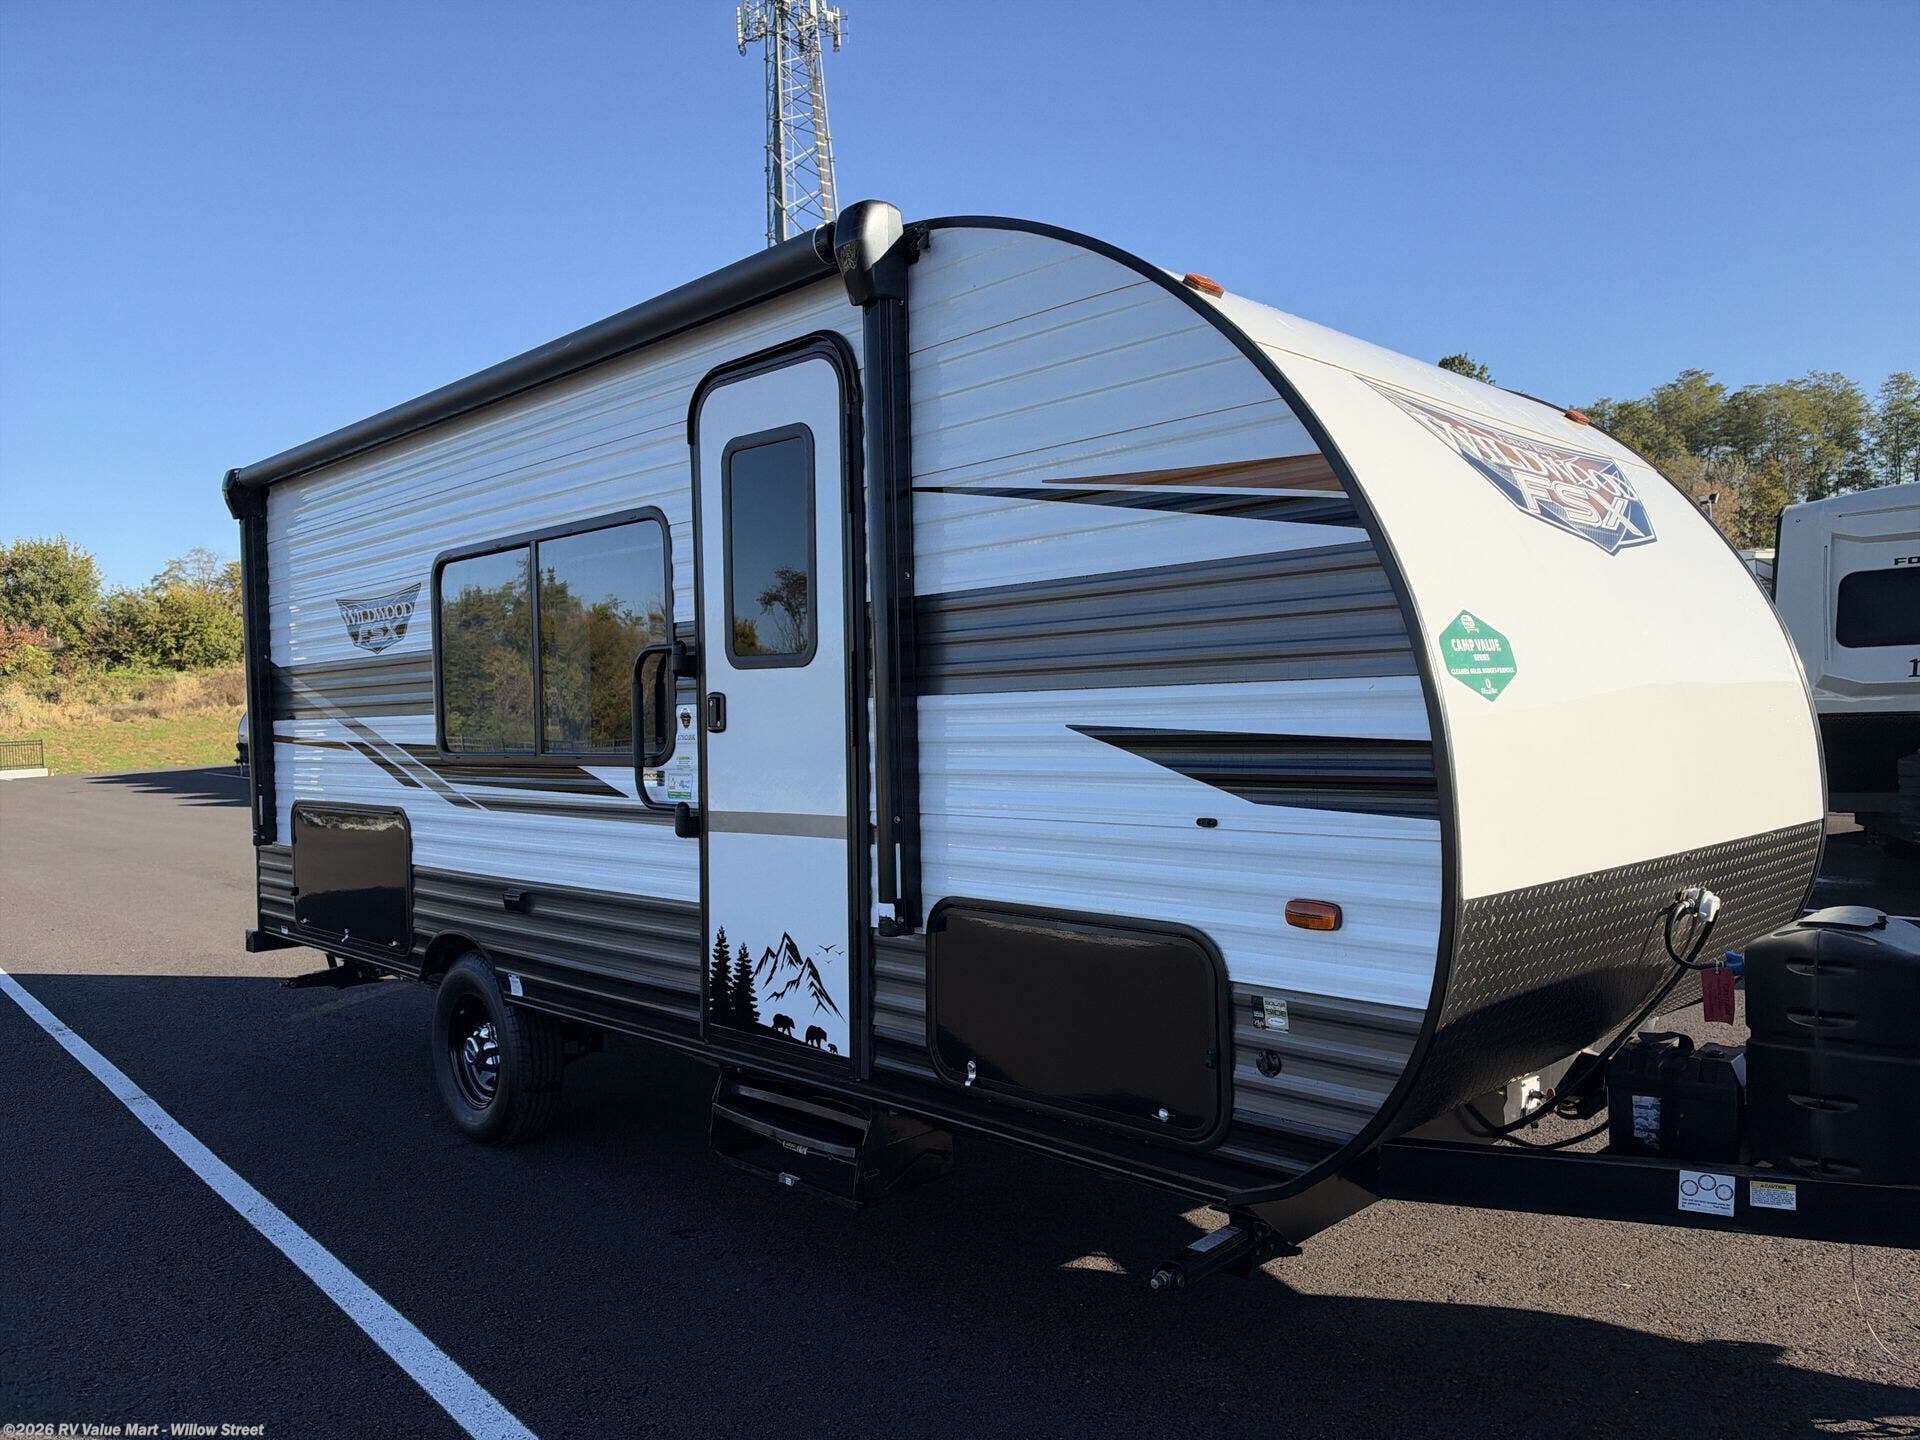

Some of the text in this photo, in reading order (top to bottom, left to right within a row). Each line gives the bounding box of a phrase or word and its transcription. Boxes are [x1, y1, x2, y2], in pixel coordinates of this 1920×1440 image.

[1511, 468, 1646, 538] FSX
[343, 602, 414, 627] WILDWOOD
[1451, 639, 1501, 651] CAMP VALUE
[1908, 658, 1920, 677] 1
